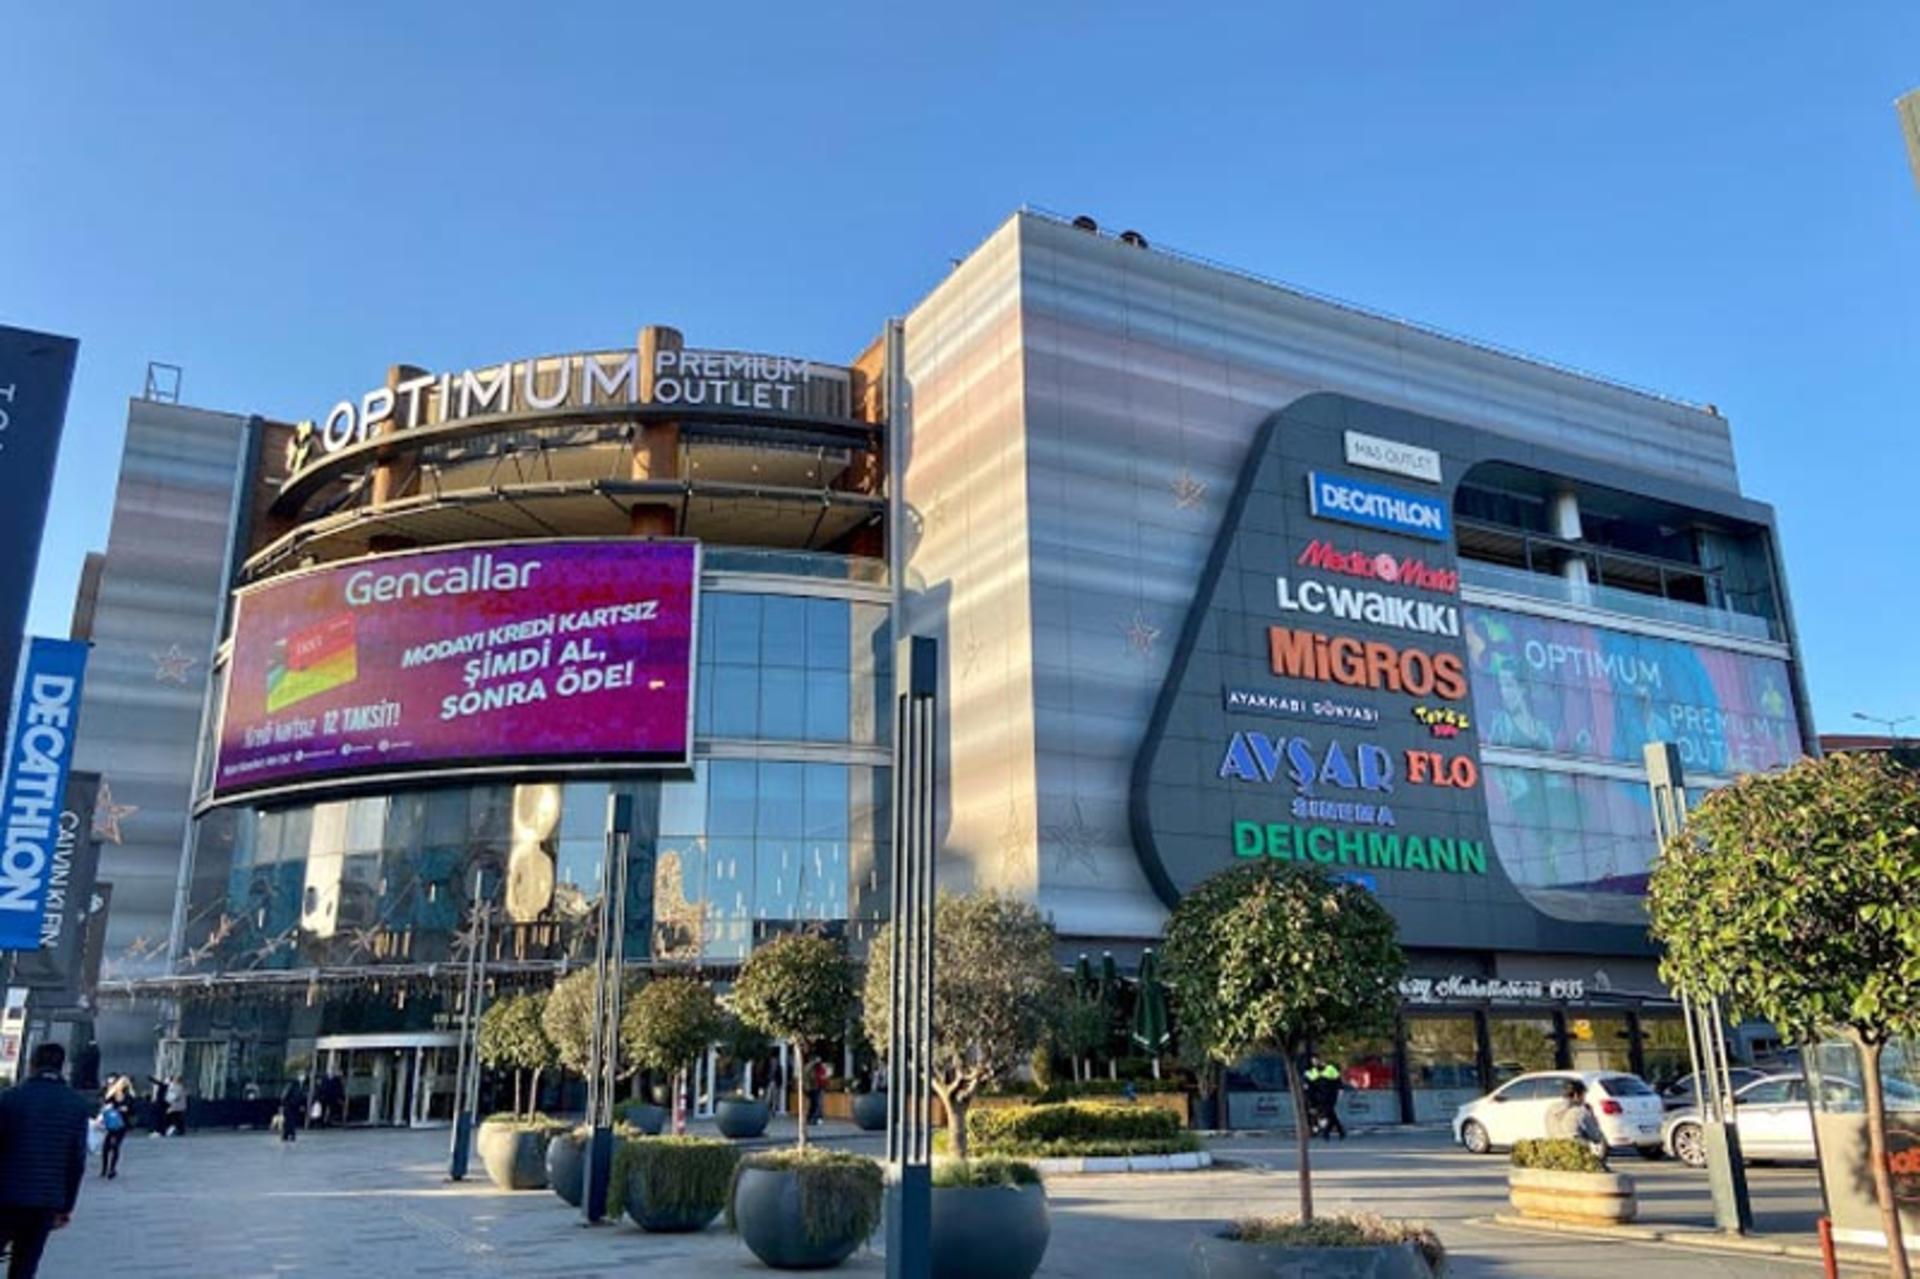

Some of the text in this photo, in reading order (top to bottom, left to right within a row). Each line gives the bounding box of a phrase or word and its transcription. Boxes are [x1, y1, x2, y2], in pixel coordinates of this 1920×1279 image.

[655, 351, 811, 382] PREMIUM
[322, 355, 639, 453] OPTIMUM
[655, 378, 797, 410] OUTLET
[1320, 482, 1442, 531] DECATHLON
[344, 554, 541, 606] Gencallar
[402, 600, 659, 668] MODAYI KREDİ KARTSIZ
[464, 637, 606, 688] ŞİMDİ AL,
[1525, 640, 1663, 689] OPTIMUM
[440, 660, 635, 721] SONRA ÖDE!
[1229, 692, 1379, 721] AYAKKABI DÜNYASI
[1219, 731, 1395, 795] AVŞAR
[1406, 750, 1479, 789] FLO
[0, 673, 75, 913] DECATHLON
[1233, 819, 1487, 874] DEICHMANN
